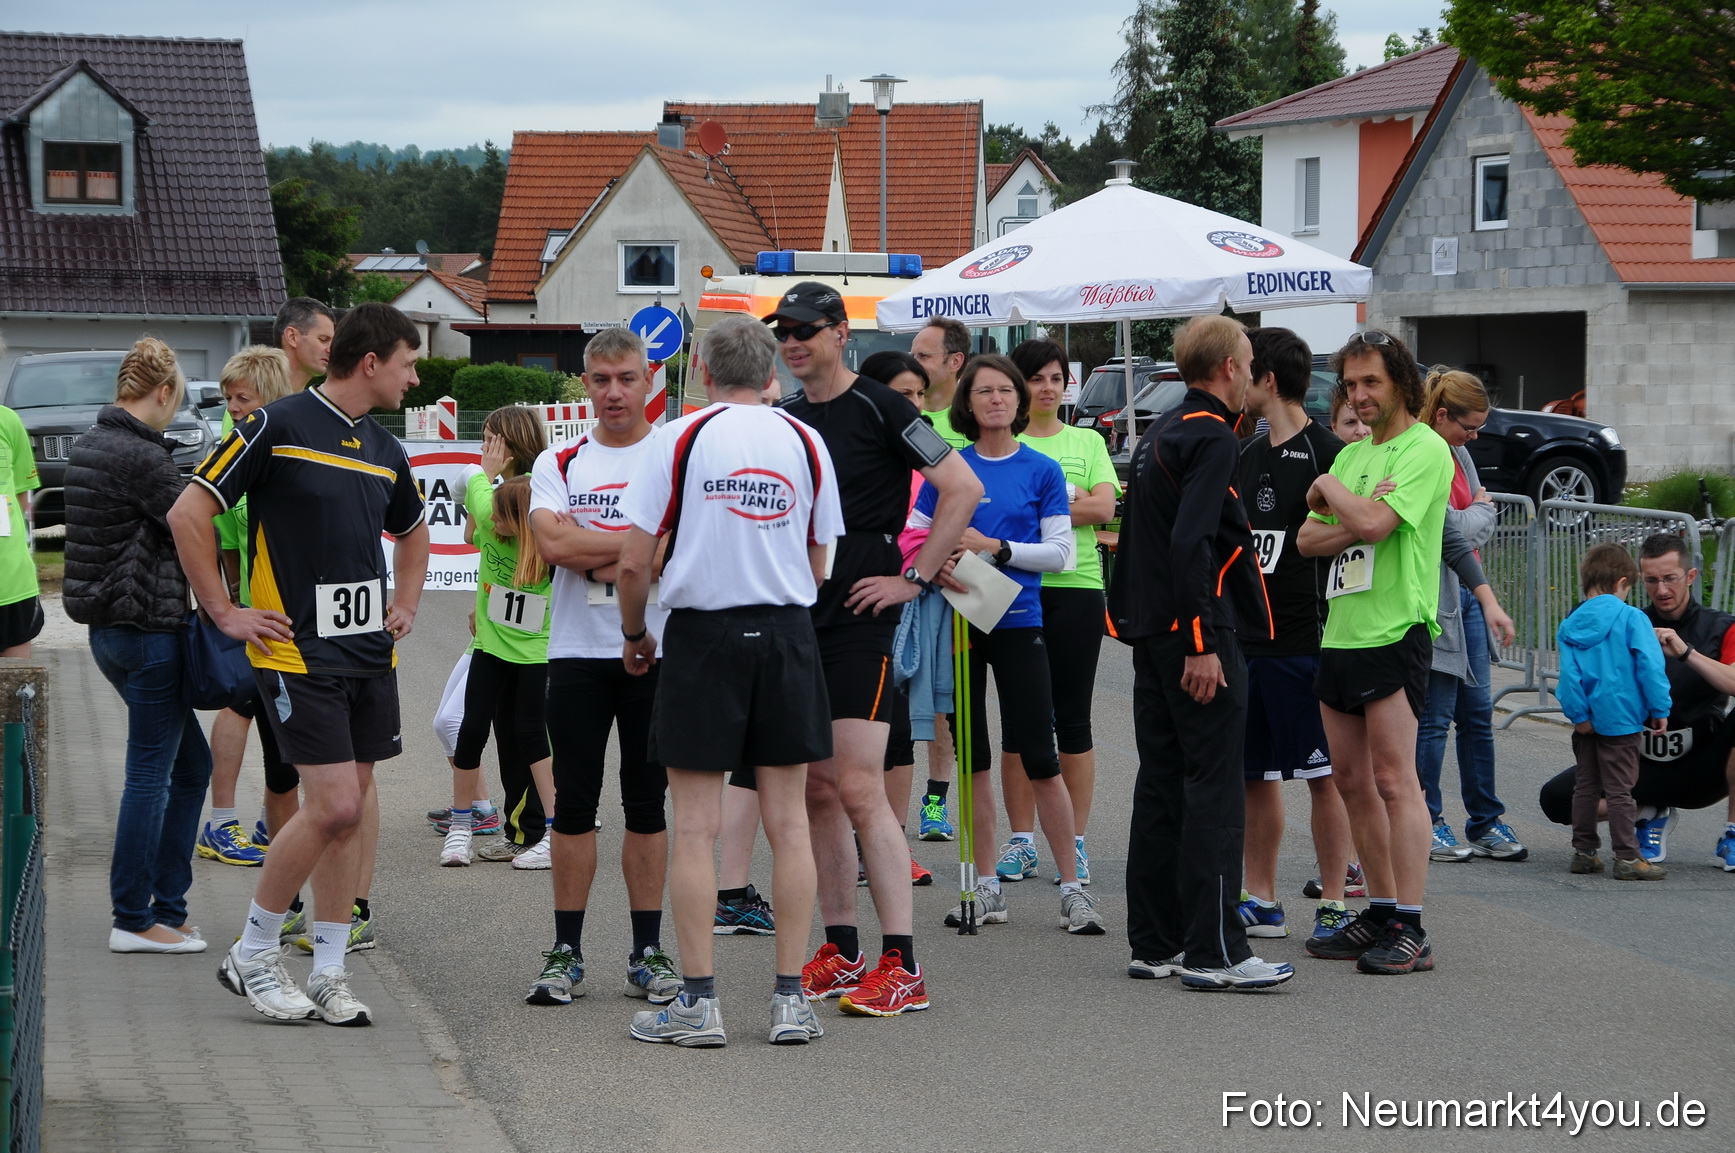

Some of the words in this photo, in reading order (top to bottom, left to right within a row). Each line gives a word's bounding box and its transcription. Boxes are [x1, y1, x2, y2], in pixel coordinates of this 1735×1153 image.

[1080, 283, 1157, 309] Weißbier
[1247, 270, 1336, 296] ERDINGER
[912, 293, 992, 319] ERDINGER
[1289, 450, 1309, 460] DEKRA
[703, 479, 780, 496] GERHART
[740, 493, 787, 511] JÄNIG
[333, 585, 371, 629] 30
[504, 591, 526, 625] 11
[1642, 729, 1684, 758] 103
[1307, 756, 1329, 765] adidas
